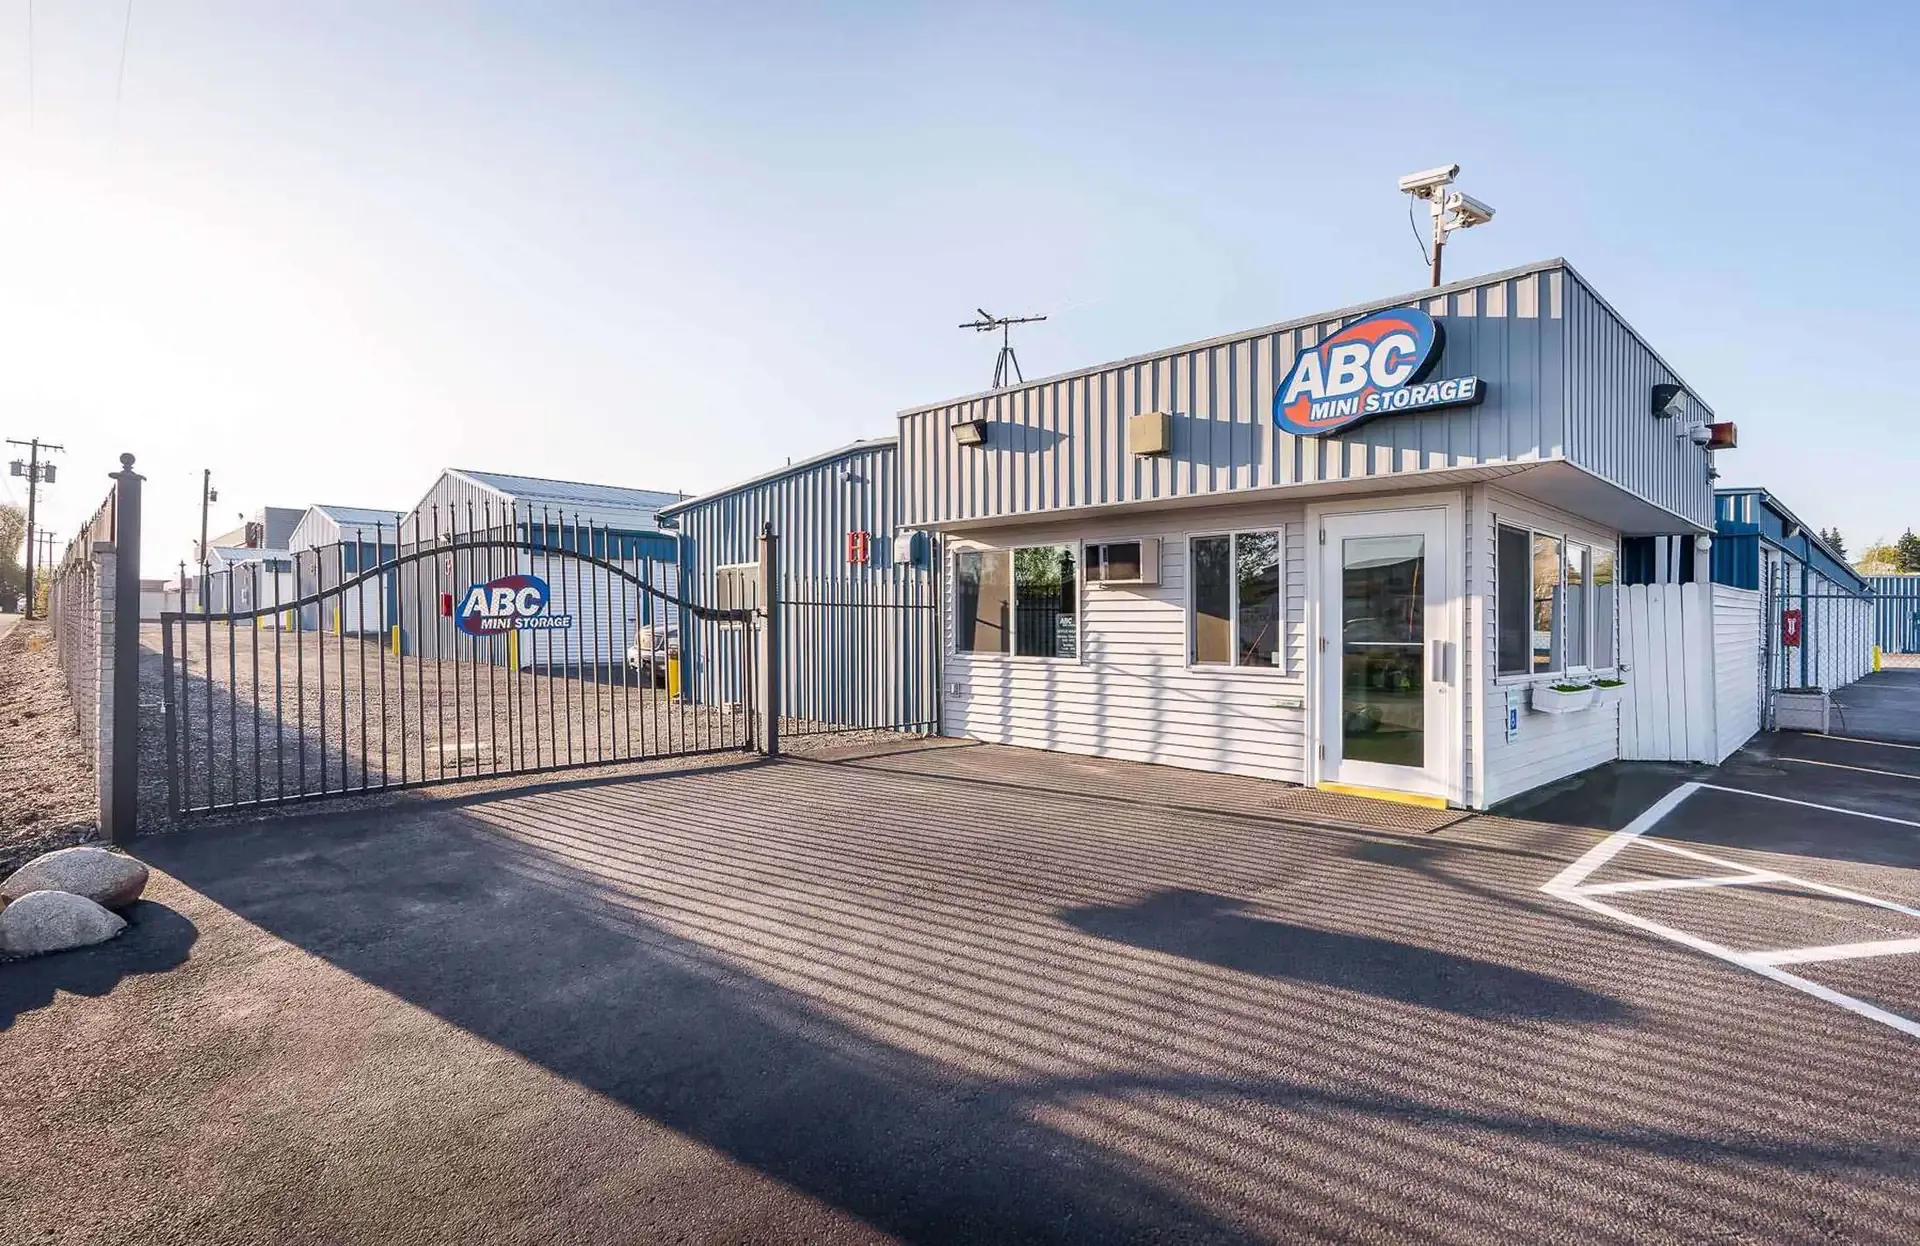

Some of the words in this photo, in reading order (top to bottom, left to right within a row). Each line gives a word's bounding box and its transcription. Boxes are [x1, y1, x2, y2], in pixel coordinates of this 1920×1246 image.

[1283, 334, 1416, 404] ABC
[1310, 398, 1359, 422] MINI
[1364, 378, 1475, 413] STORAGE
[847, 531, 869, 563] H
[461, 587, 541, 617] ABC
[481, 618, 511, 629] MINI
[514, 616, 571, 628] STORAGE
